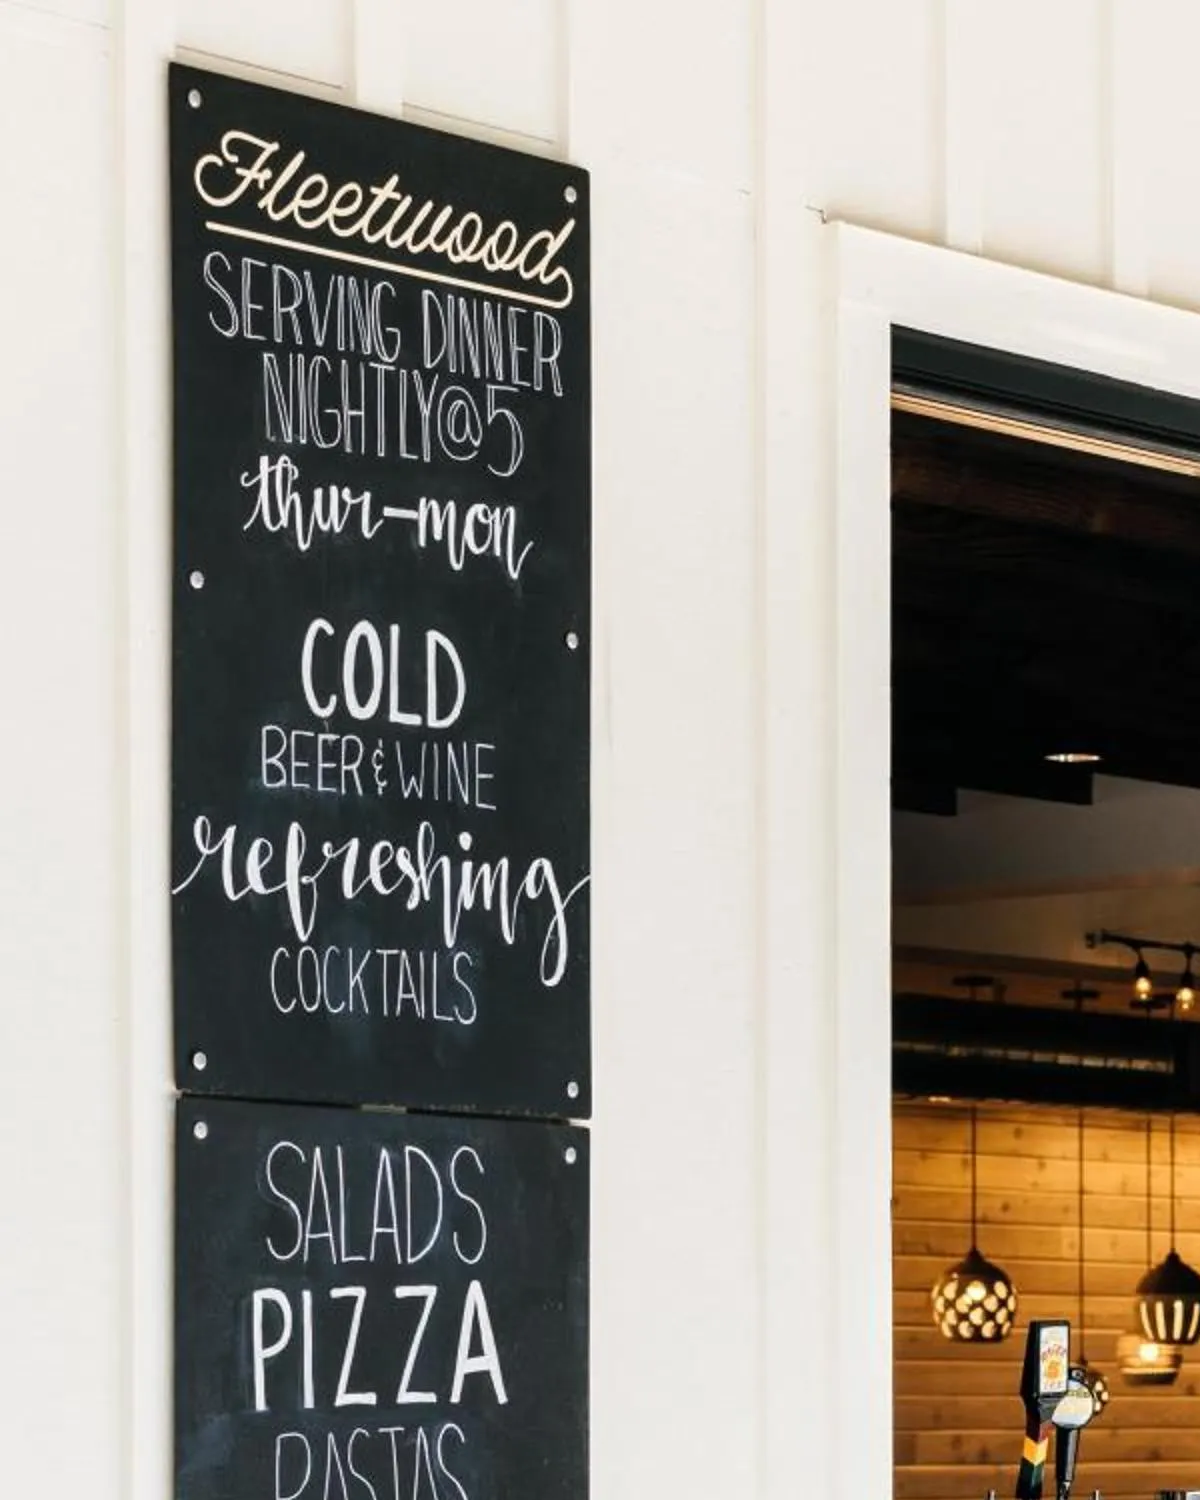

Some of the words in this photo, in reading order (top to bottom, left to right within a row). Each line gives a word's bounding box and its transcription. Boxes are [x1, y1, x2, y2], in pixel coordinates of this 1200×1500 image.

[194, 129, 574, 288] Fleetwood
[203, 251, 401, 363] SERVING
[421, 288, 563, 397] DINNER
[301, 618, 467, 729] COLD
[171, 815, 592, 987] refreshing
[270, 945, 478, 1025] COCKTAILS
[265, 1141, 487, 1265] SALADS
[252, 1279, 509, 1412] PIZZA
